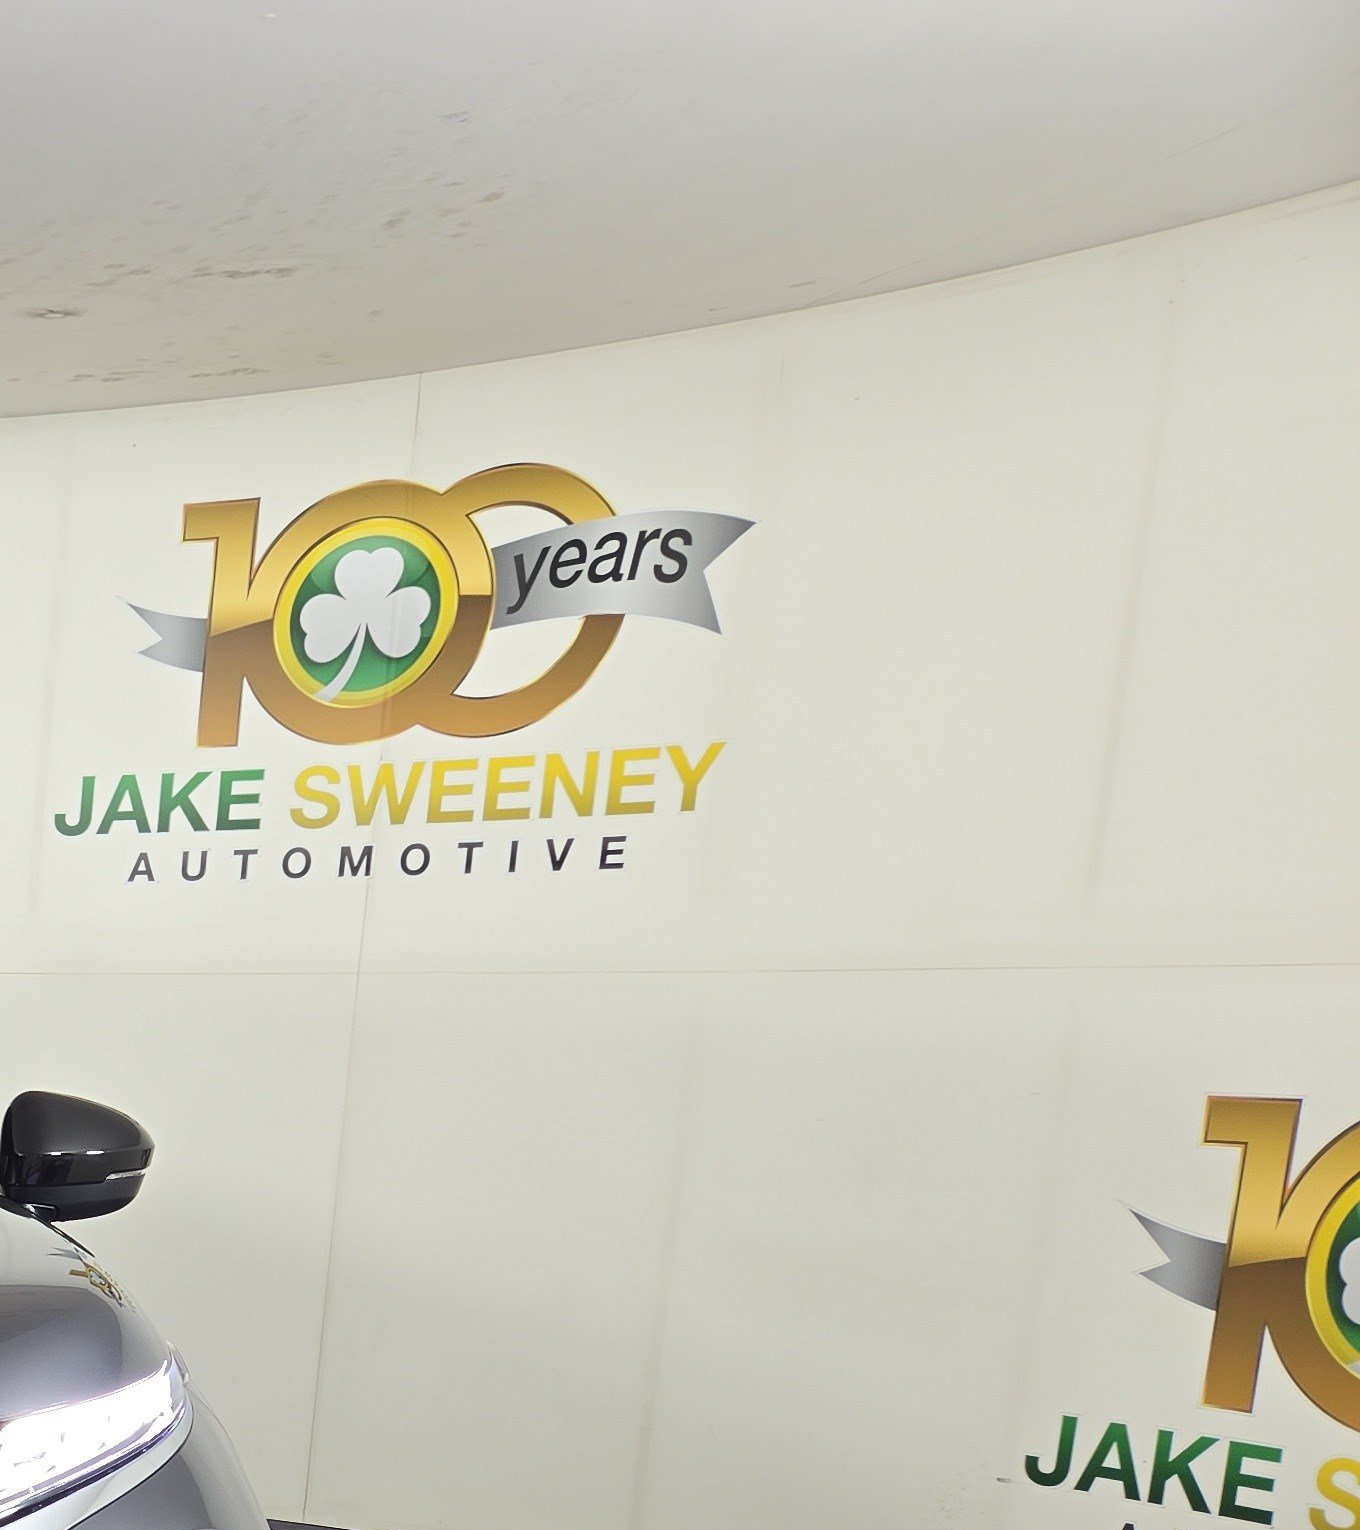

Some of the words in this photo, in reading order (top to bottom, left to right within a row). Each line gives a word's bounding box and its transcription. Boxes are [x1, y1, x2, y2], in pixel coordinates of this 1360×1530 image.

[182, 463, 626, 748] 100
[506, 526, 693, 616] years
[54, 769, 265, 837] JAKE
[289, 742, 727, 830] SWEENEY
[127, 836, 628, 883] AUTOMOTIVE
[1024, 1415, 1283, 1526] JAKE
